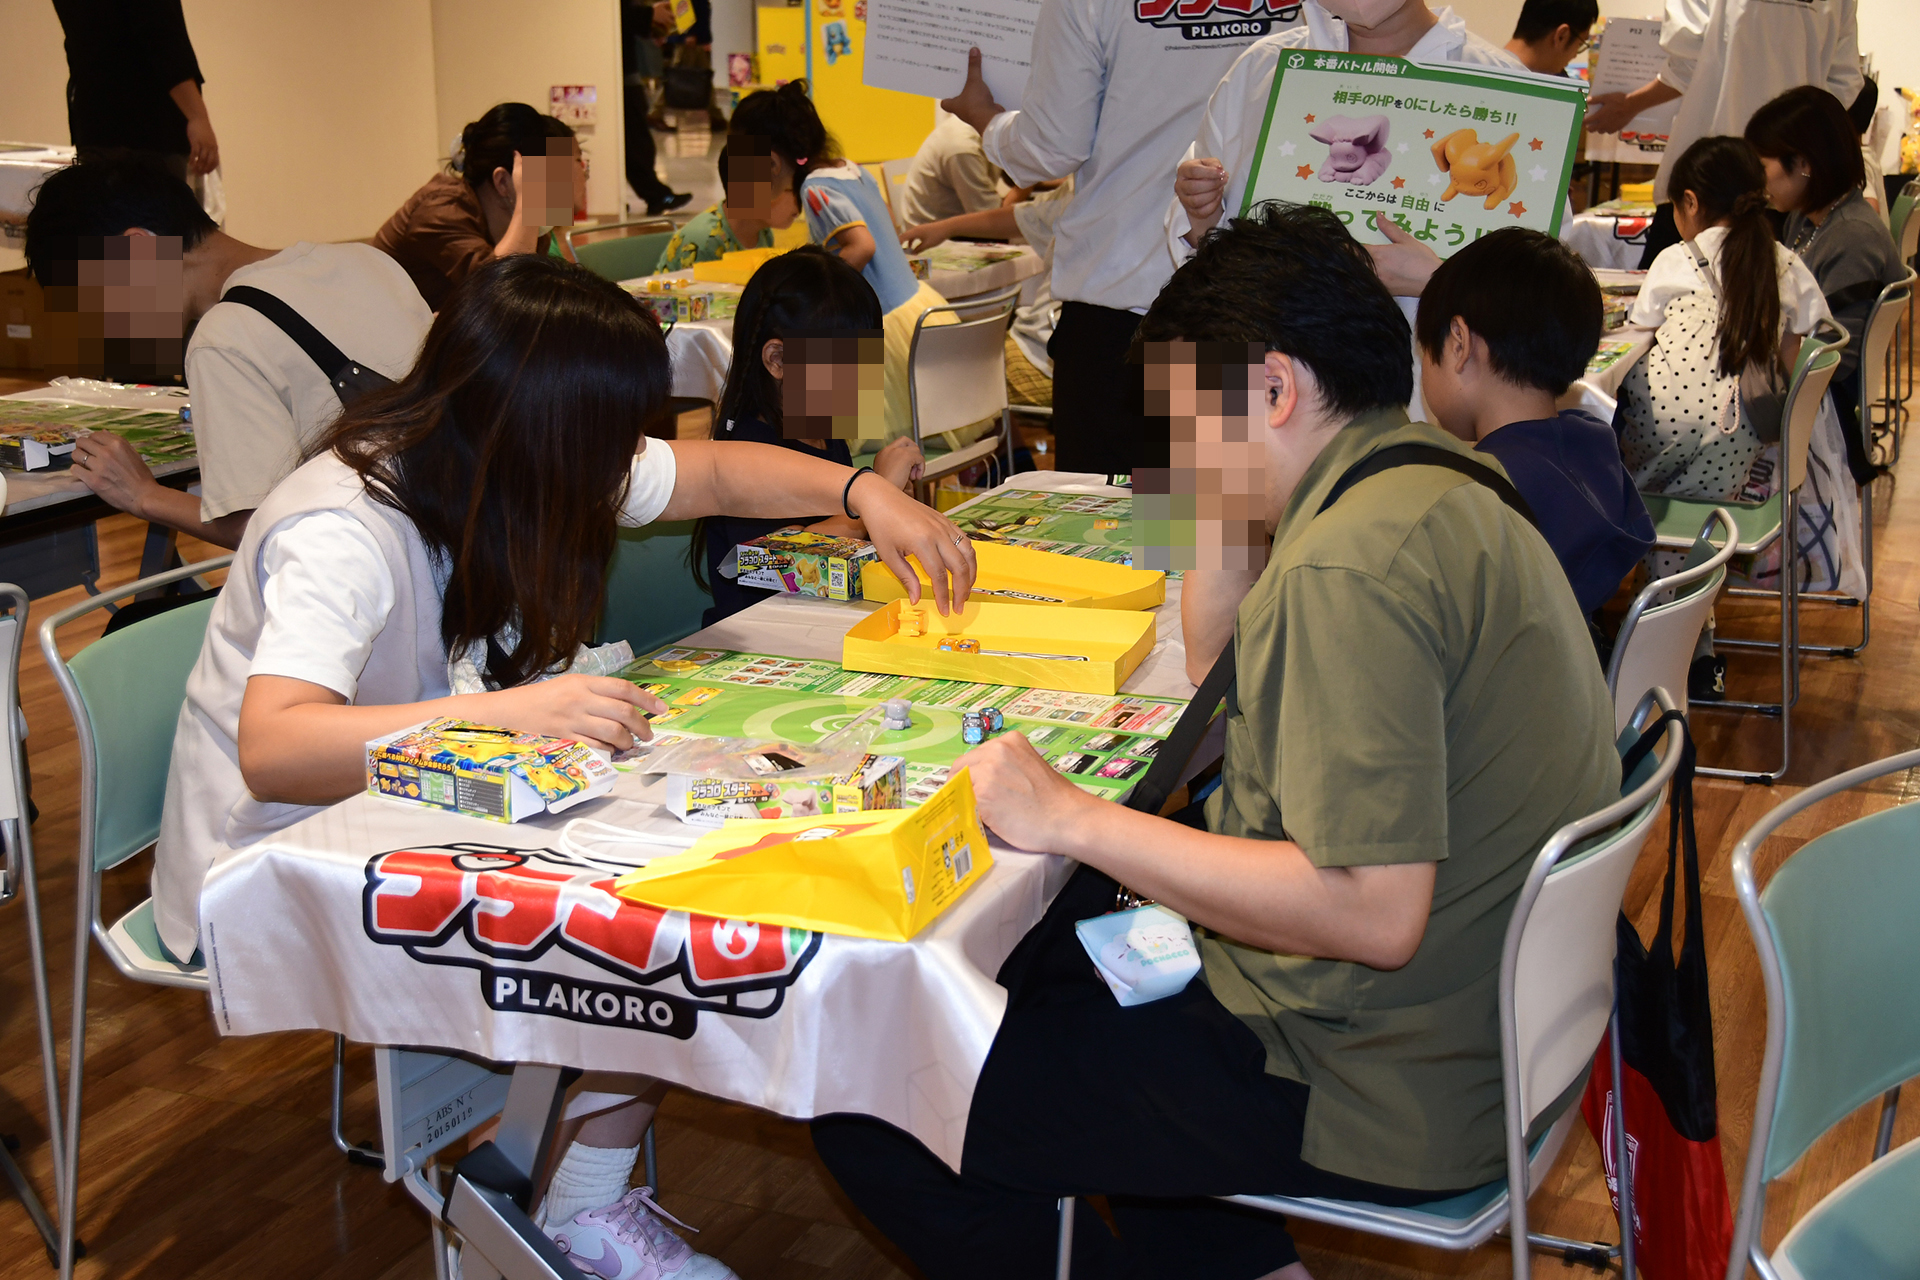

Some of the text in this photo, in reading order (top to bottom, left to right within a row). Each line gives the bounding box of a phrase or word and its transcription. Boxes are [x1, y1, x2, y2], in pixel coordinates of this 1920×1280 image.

[1191, 22, 1262, 38] PLAKORO
[723, 782, 752, 797] スタート
[1140, 948, 1190, 967] POCHACCO
[494, 975, 676, 1030] PLAKORO
[436, 1102, 453, 1123] ABS
